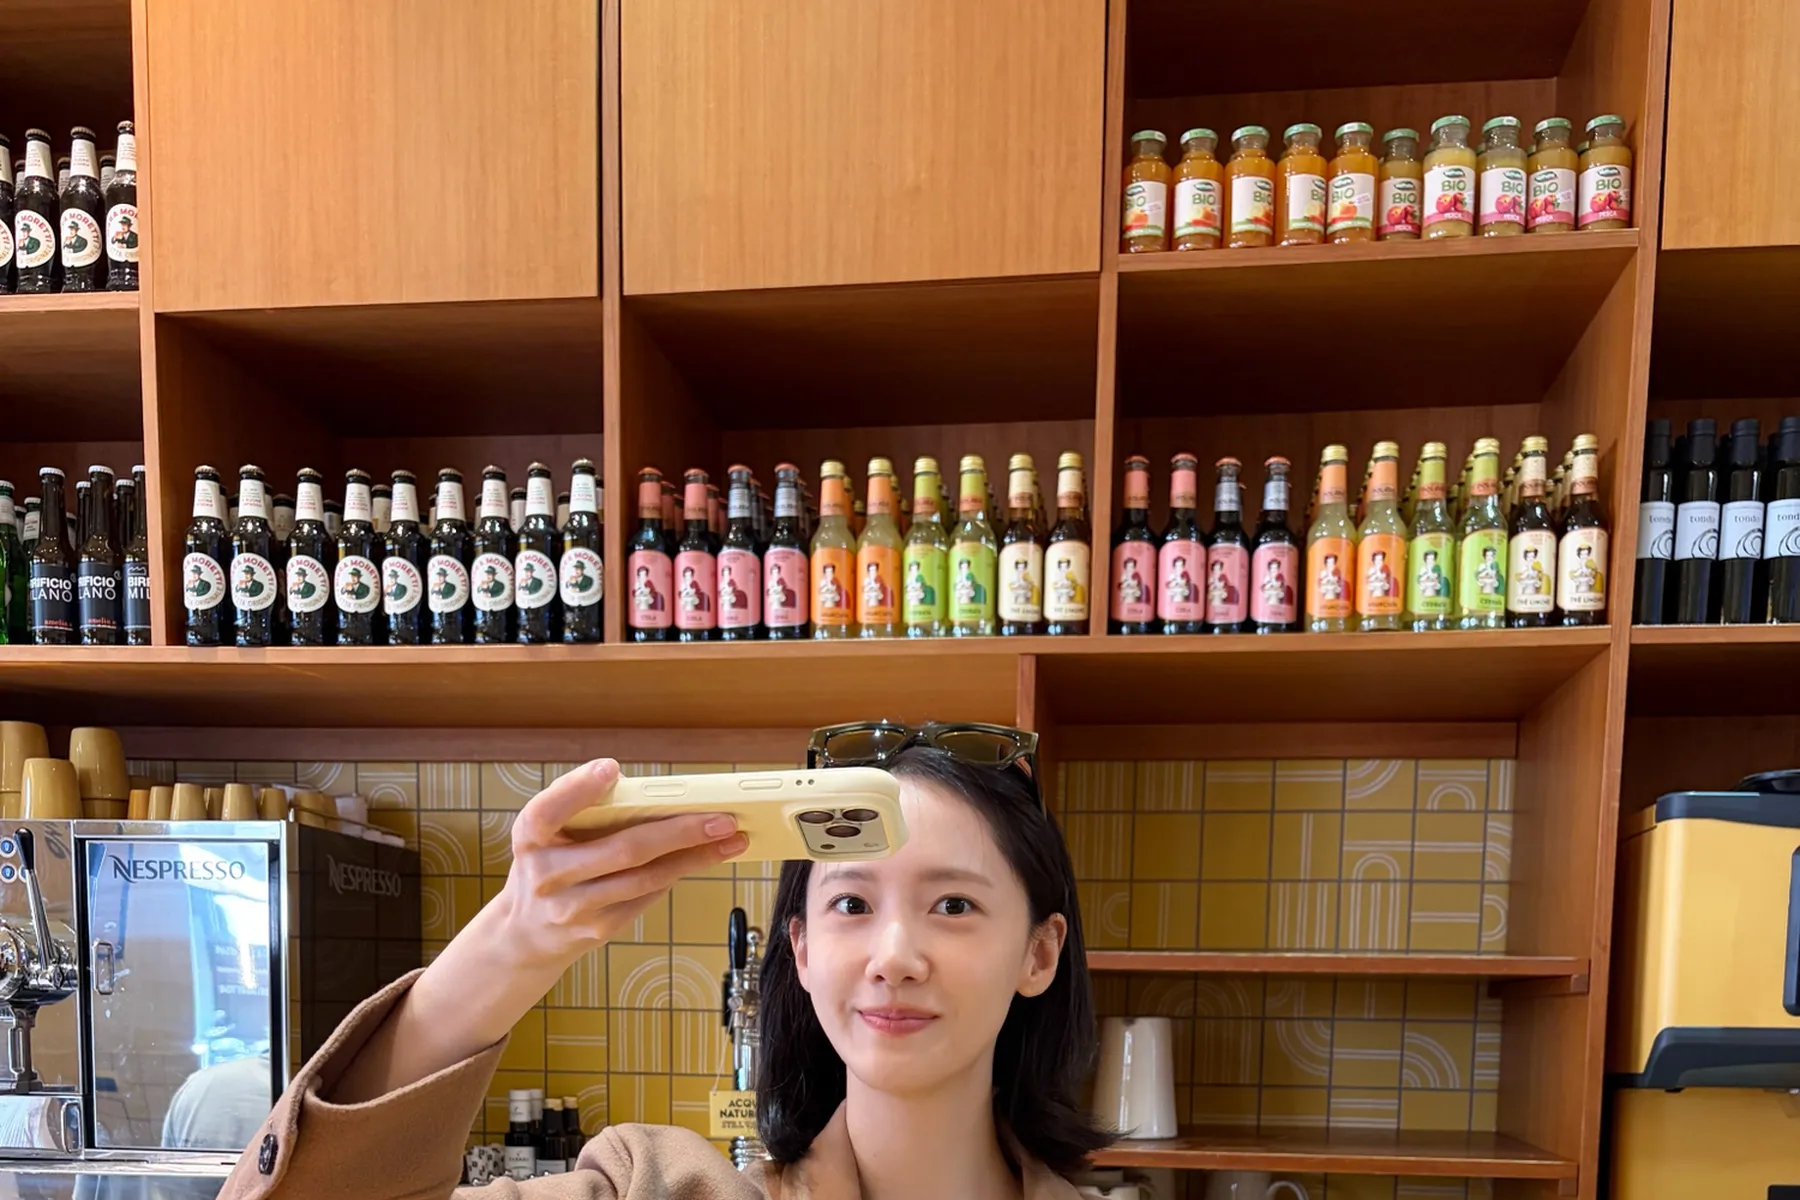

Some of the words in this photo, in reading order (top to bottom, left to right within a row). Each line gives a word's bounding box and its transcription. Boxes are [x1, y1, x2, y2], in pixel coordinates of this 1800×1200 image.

[1332, 187, 1355, 203] BIO
[1442, 179, 1467, 192] BIO
[1502, 181, 1523, 194] BIO
[1533, 181, 1559, 197] BIO
[1596, 177, 1622, 191] BIO
[1192, 193, 1217, 205] BIO
[1392, 192, 1417, 204] BIO
[21, 214, 53, 244] MORETTI
[69, 212, 101, 245] MORETTI
[1649, 514, 1672, 524] tondo
[1690, 514, 1716, 524] tondo
[1734, 514, 1760, 523] tondo
[192, 557, 223, 587] MORETTI
[243, 557, 275, 586] MORETTI
[296, 559, 328, 588] MORETTI
[350, 560, 380, 589] MORETTI
[388, 561, 419, 588] MORETTI
[437, 559, 467, 587] MORETTI
[524, 554, 555, 584] MORETTI
[108, 855, 246, 883] NESPRESSO
[326, 855, 401, 897] NESPRESSO
